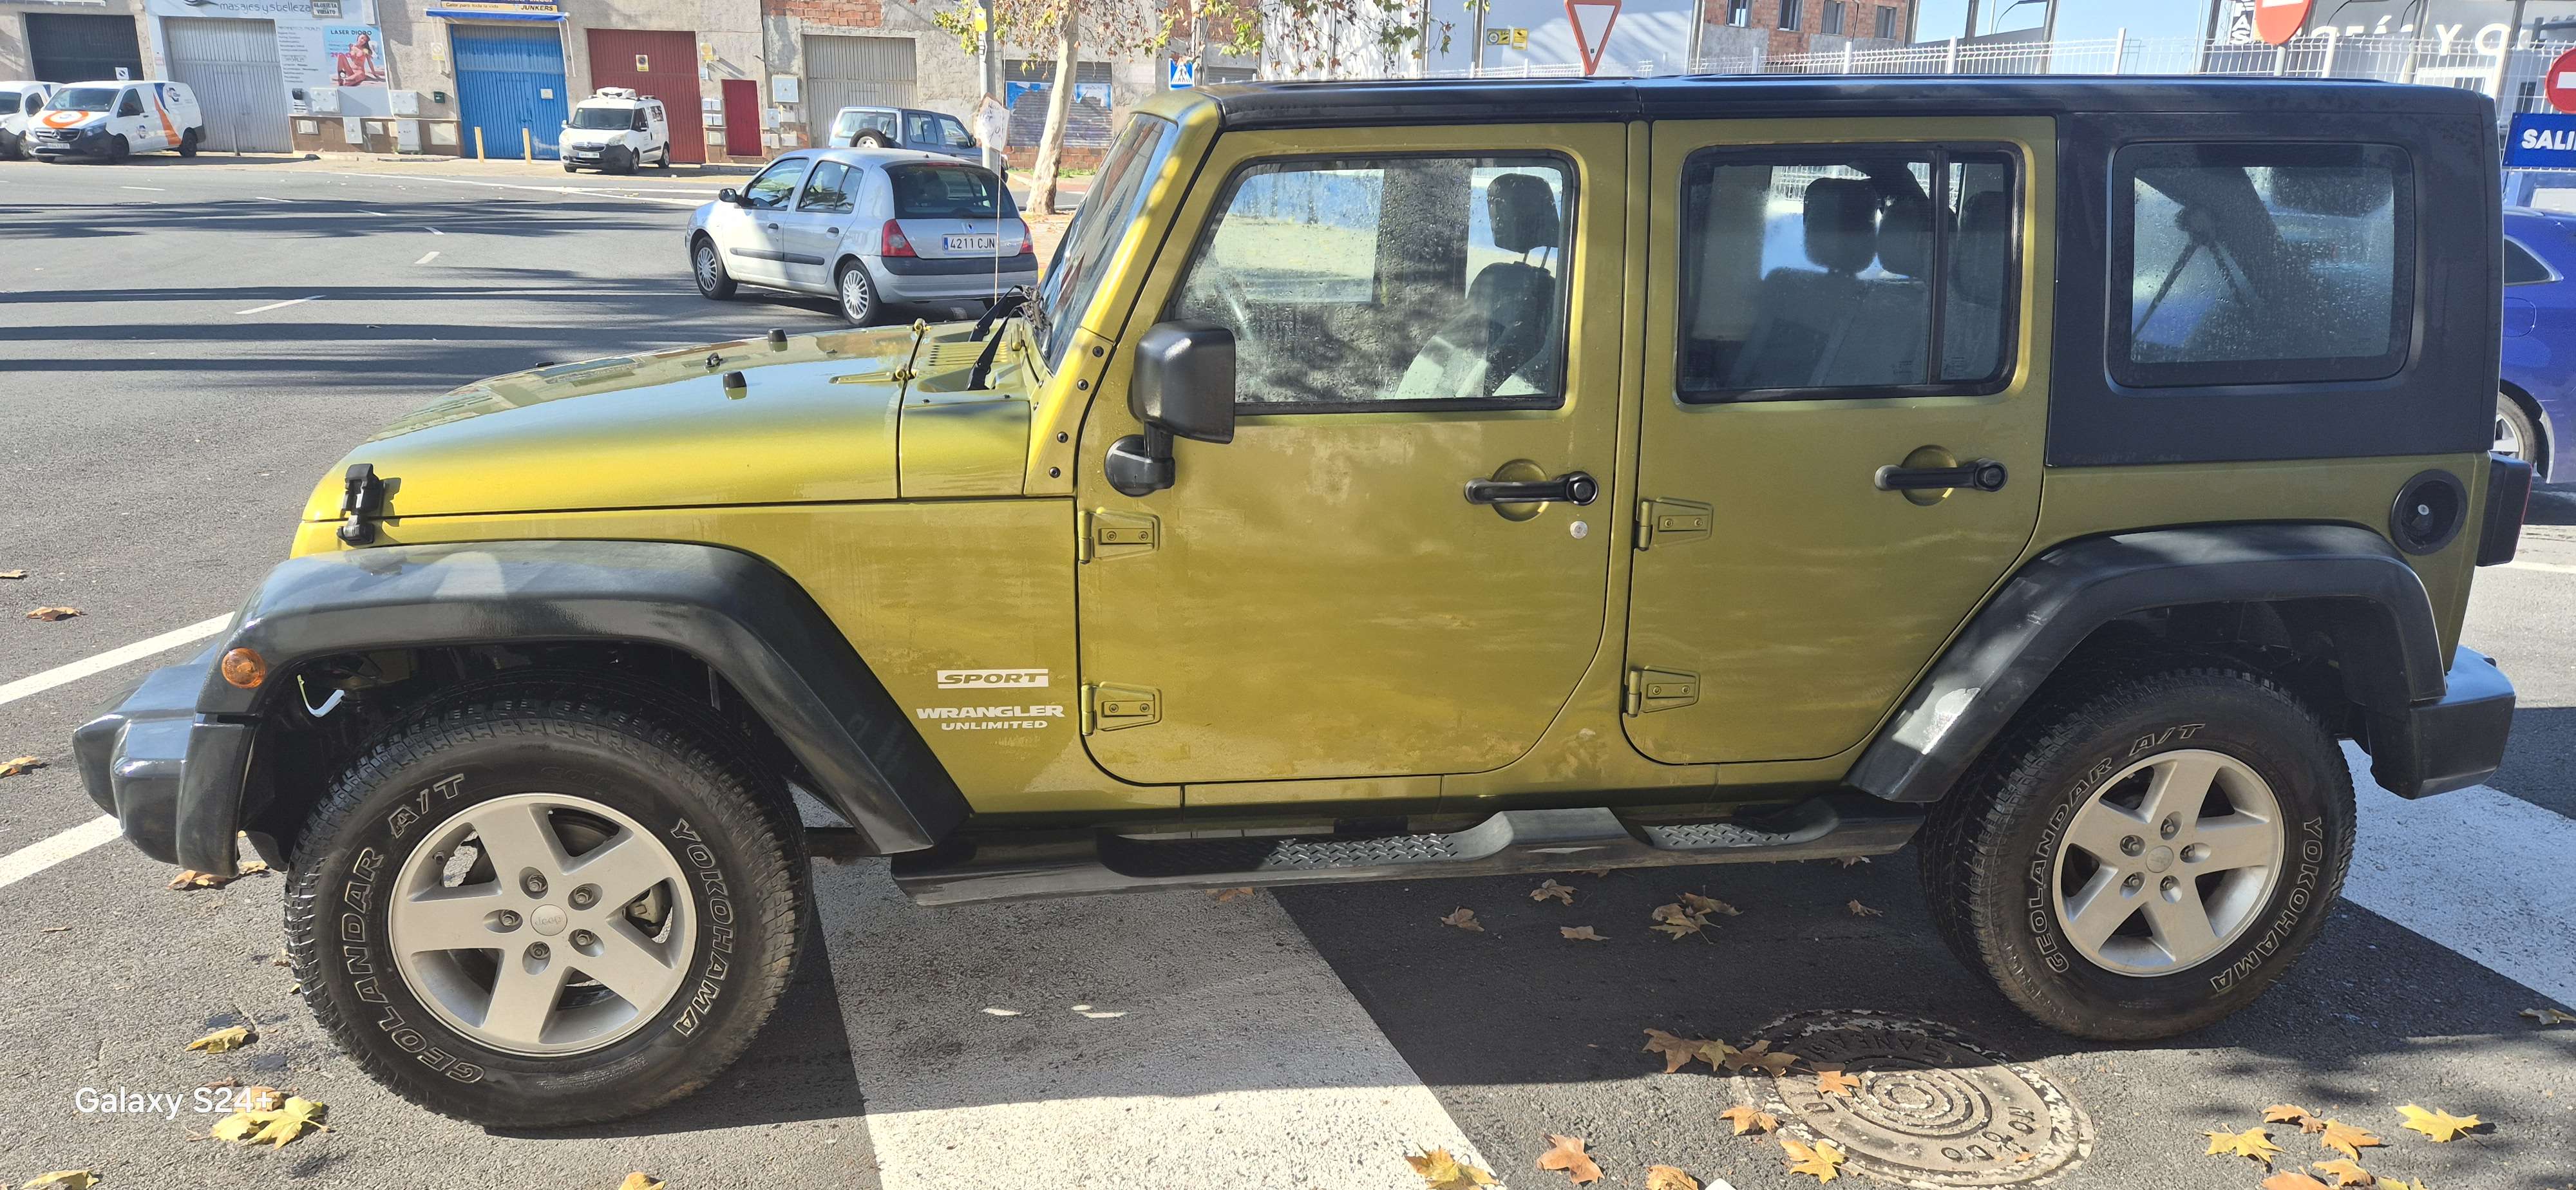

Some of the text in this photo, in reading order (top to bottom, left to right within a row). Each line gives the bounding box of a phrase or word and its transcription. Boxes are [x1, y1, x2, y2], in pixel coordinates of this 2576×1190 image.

[2521, 129, 2576, 151] SALI
[951, 238, 974, 249] 4211
[978, 238, 995, 249] CJN
[938, 671, 1048, 686] SPORT
[916, 705, 1065, 719] WRANGLER
[941, 720, 1048, 731] UNLIMITED
[2030, 723, 2206, 973] GEOLANDAR A/T
[2209, 816, 2323, 994] YOKOHAMA
[340, 773, 486, 1084] GEOLANDAR A/T
[535, 914, 563, 927] Jeep
[670, 818, 737, 1038] YOKOHAMA
